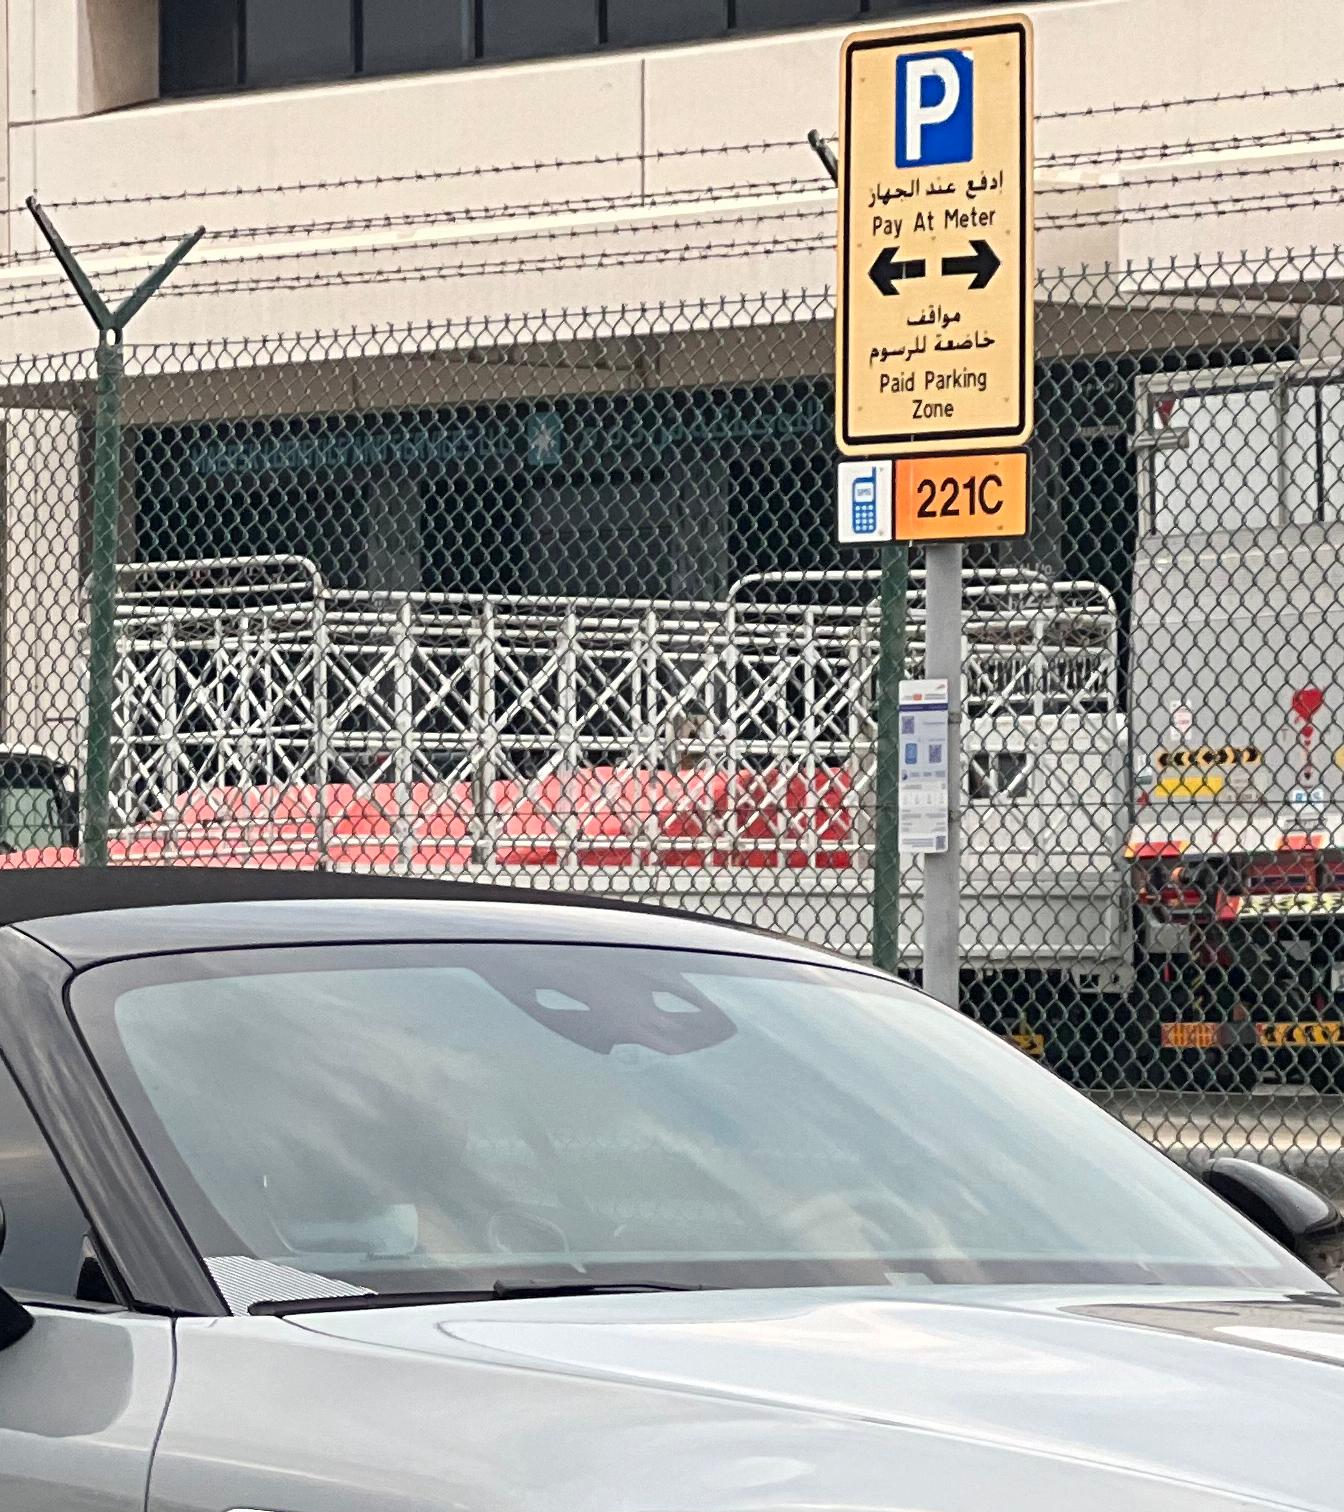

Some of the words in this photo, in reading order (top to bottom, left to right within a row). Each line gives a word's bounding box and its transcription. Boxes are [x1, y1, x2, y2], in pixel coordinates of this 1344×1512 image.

[905, 57, 960, 161] P
[868, 178, 920, 208] الجهاز
[925, 176, 956, 196] عند
[872, 216, 903, 239] Pay
[913, 210, 935, 232] At
[944, 206, 996, 230] Meter
[906, 304, 961, 329] مواقف
[869, 333, 927, 369] للرسوم
[934, 329, 996, 352] خاضعة
[879, 371, 916, 394] Paid
[924, 366, 988, 392] Parking
[912, 399, 955, 419] Zone
[916, 474, 1004, 518] 221C
